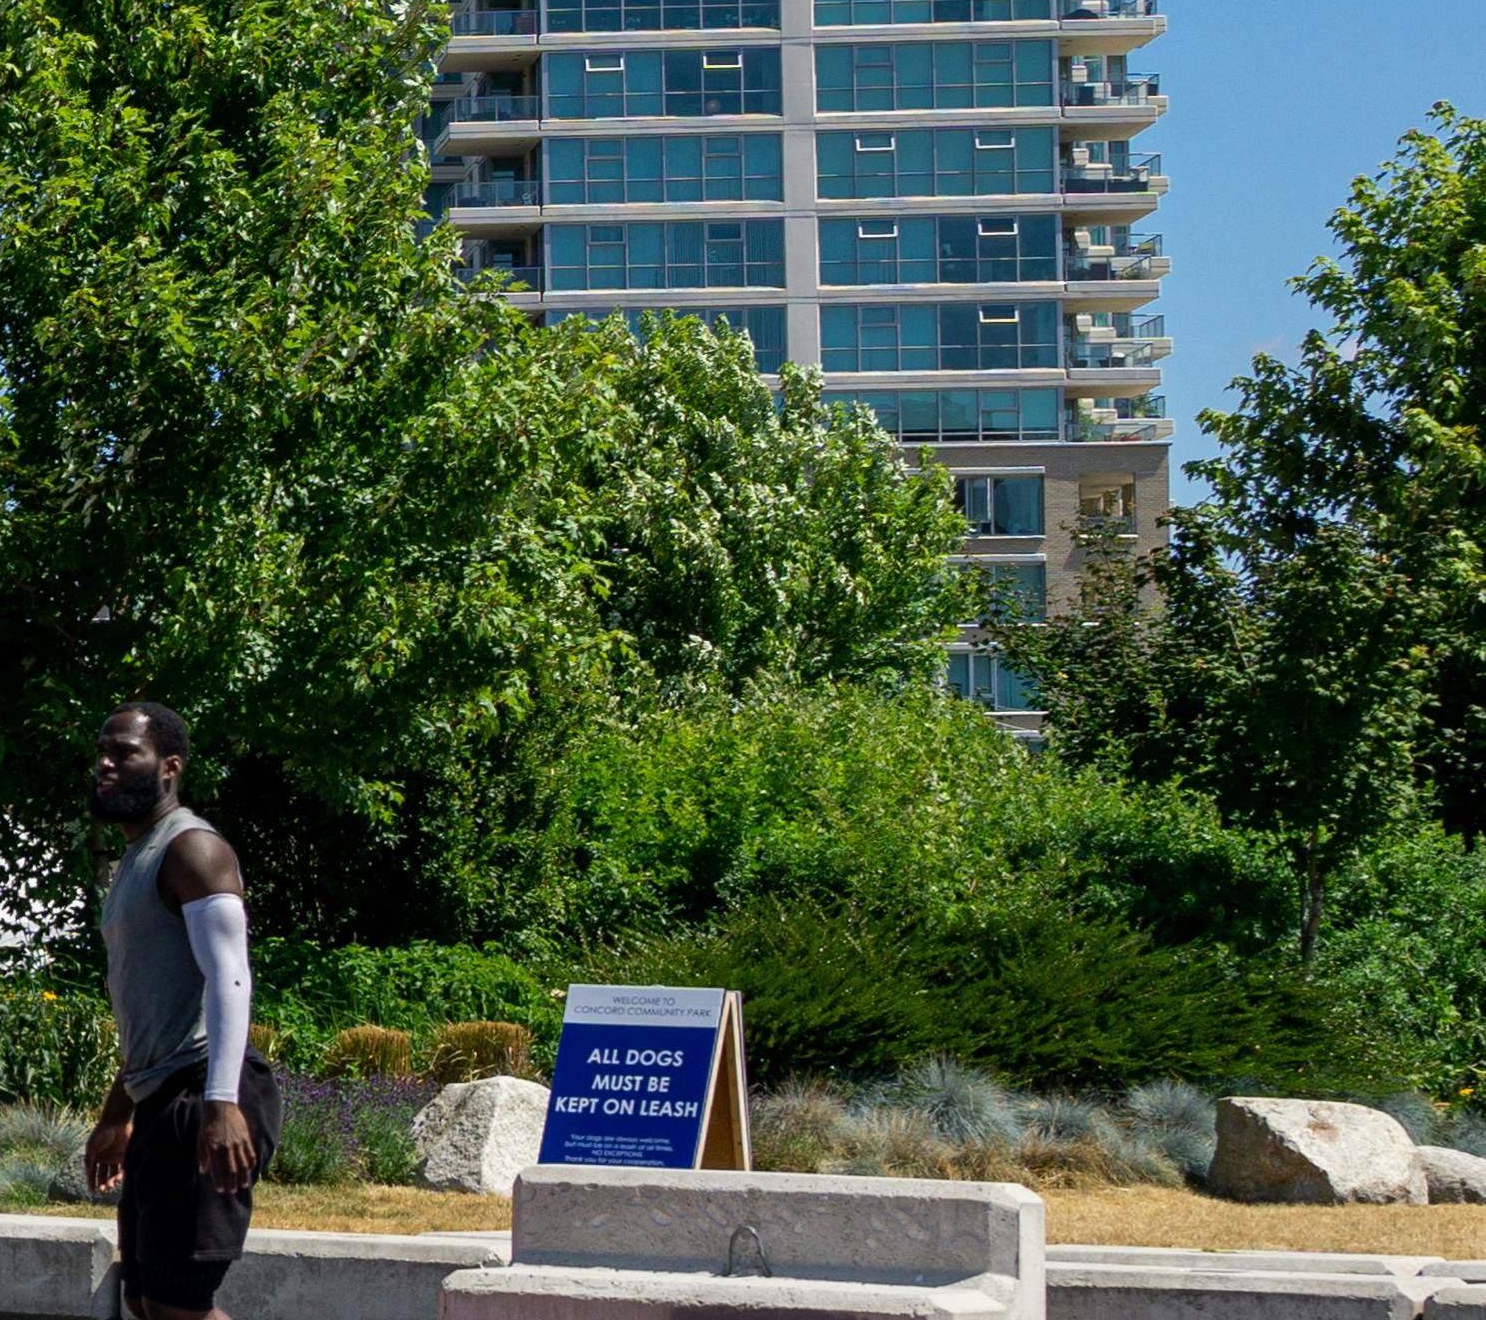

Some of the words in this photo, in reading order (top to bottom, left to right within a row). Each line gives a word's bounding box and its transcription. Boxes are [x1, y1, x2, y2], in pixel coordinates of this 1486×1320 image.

[613, 997, 660, 1006] WELCOME
[663, 997, 676, 1006] TO
[574, 1006, 625, 1015] CONCORD
[627, 1007, 685, 1016] COMMUNITY
[687, 1009, 711, 1017] PARK
[587, 1048, 620, 1064] ALL
[625, 1049, 684, 1067] DOGS
[591, 1075, 644, 1092] MUST
[647, 1076, 670, 1093] BE
[555, 1097, 599, 1114] KEPT
[603, 1099, 635, 1115] ON
[639, 1100, 698, 1118] LEASH
